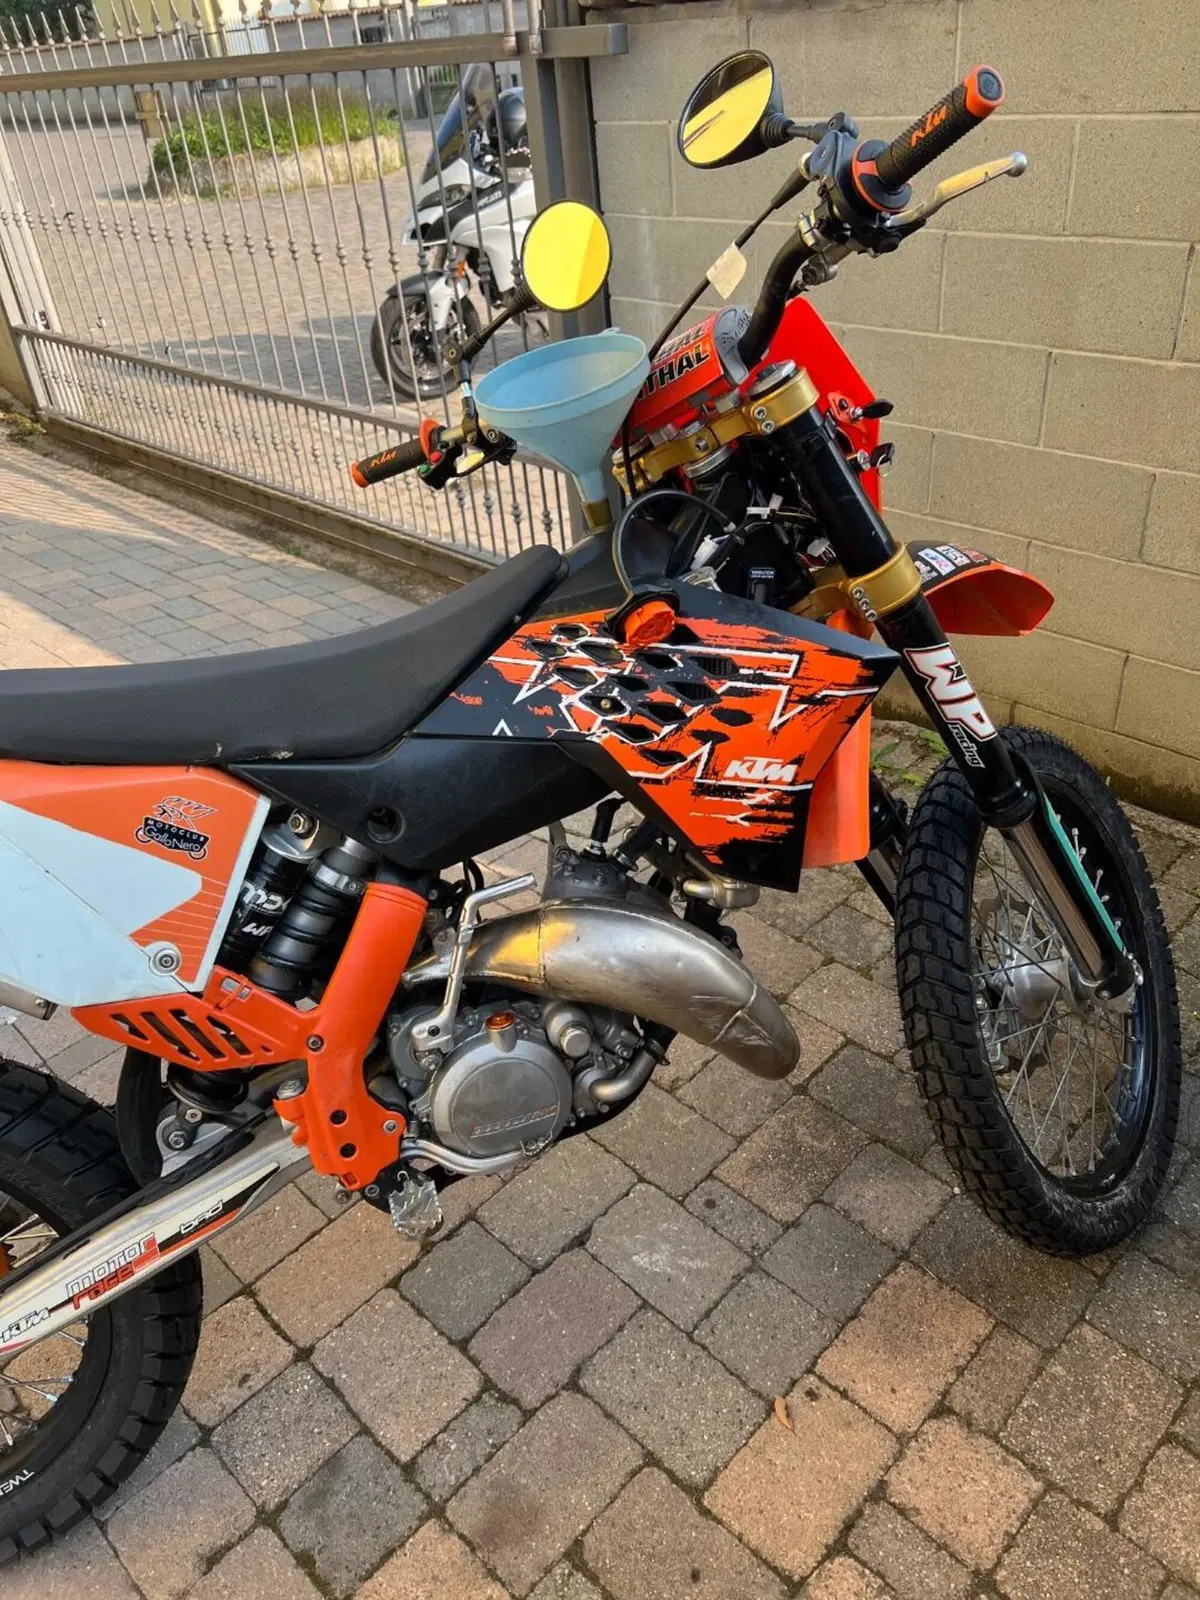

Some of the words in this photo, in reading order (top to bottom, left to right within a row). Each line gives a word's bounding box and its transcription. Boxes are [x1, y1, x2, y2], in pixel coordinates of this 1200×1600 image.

[910, 103, 948, 148] KTM
[903, 642, 998, 742] WP
[947, 723, 986, 768] racing
[723, 756, 799, 783] KTM
[147, 819, 205, 842] MOTOCLUB
[2, 1306, 51, 1343] KTM
